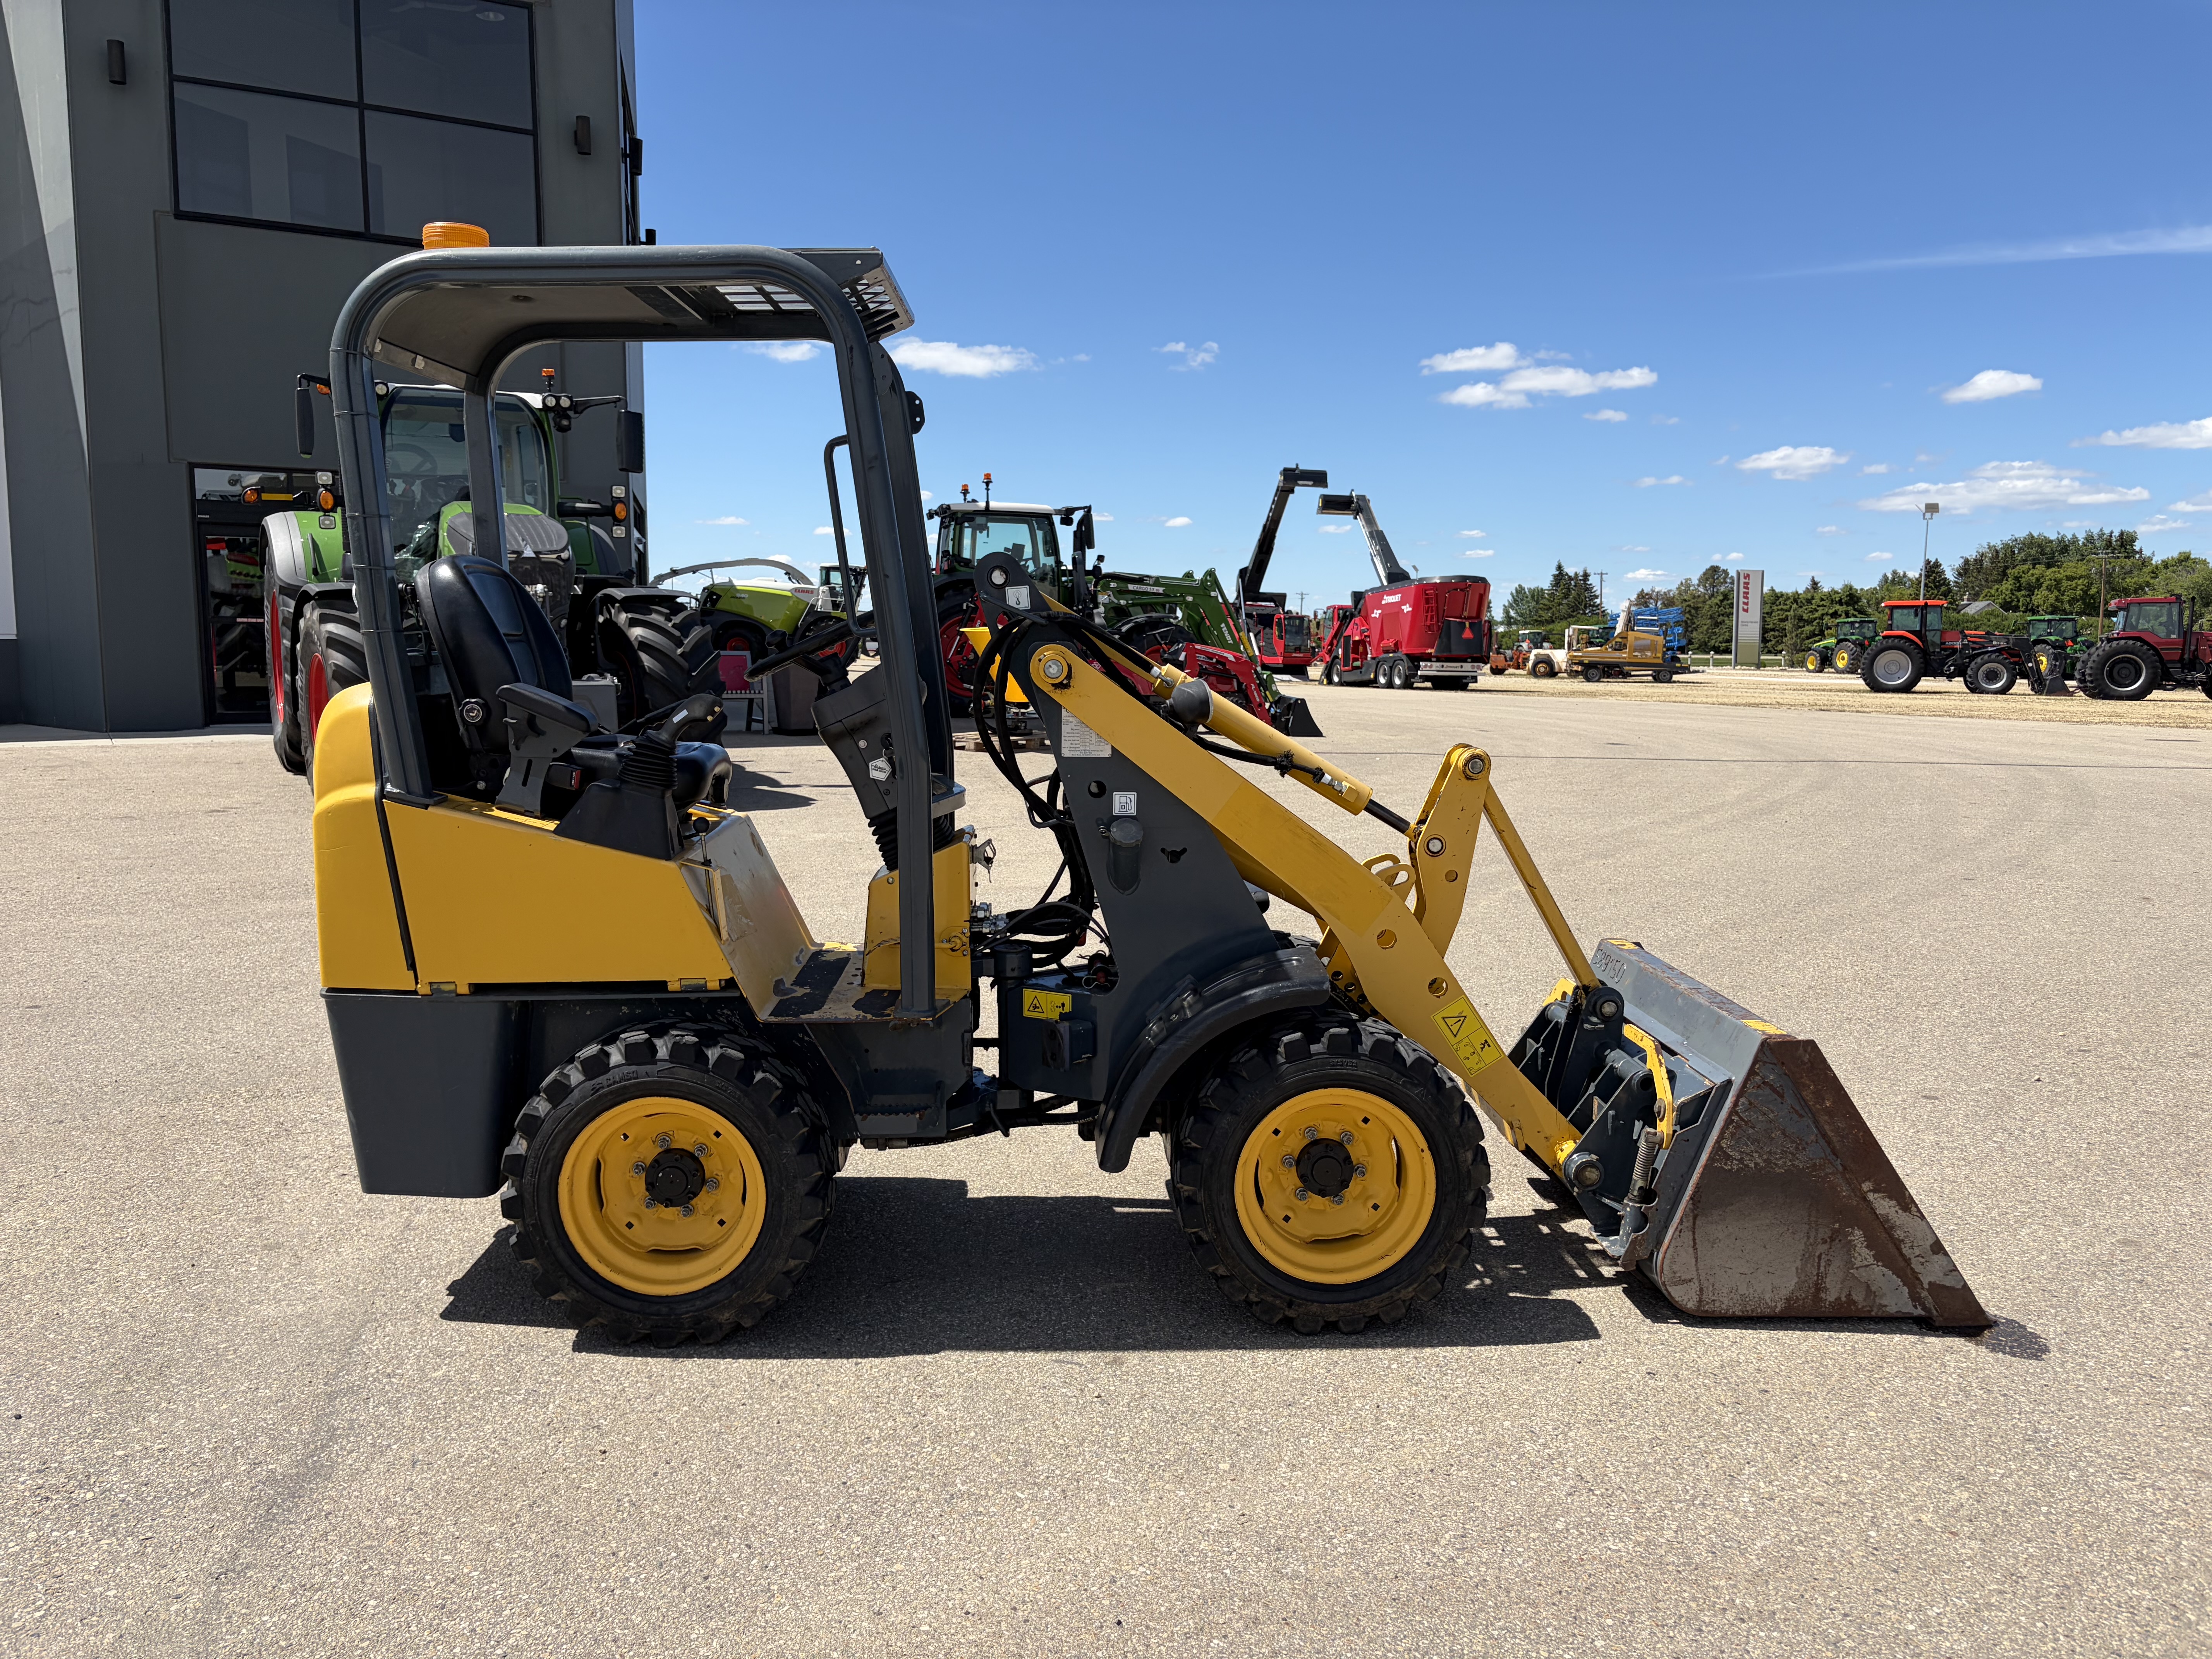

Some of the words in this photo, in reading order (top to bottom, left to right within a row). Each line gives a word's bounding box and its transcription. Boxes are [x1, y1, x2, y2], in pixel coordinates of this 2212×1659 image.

[1742, 573, 1750, 613] CLAAS
[1220, 623, 1233, 644] FENDT
[1593, 948, 1626, 984] 589150
